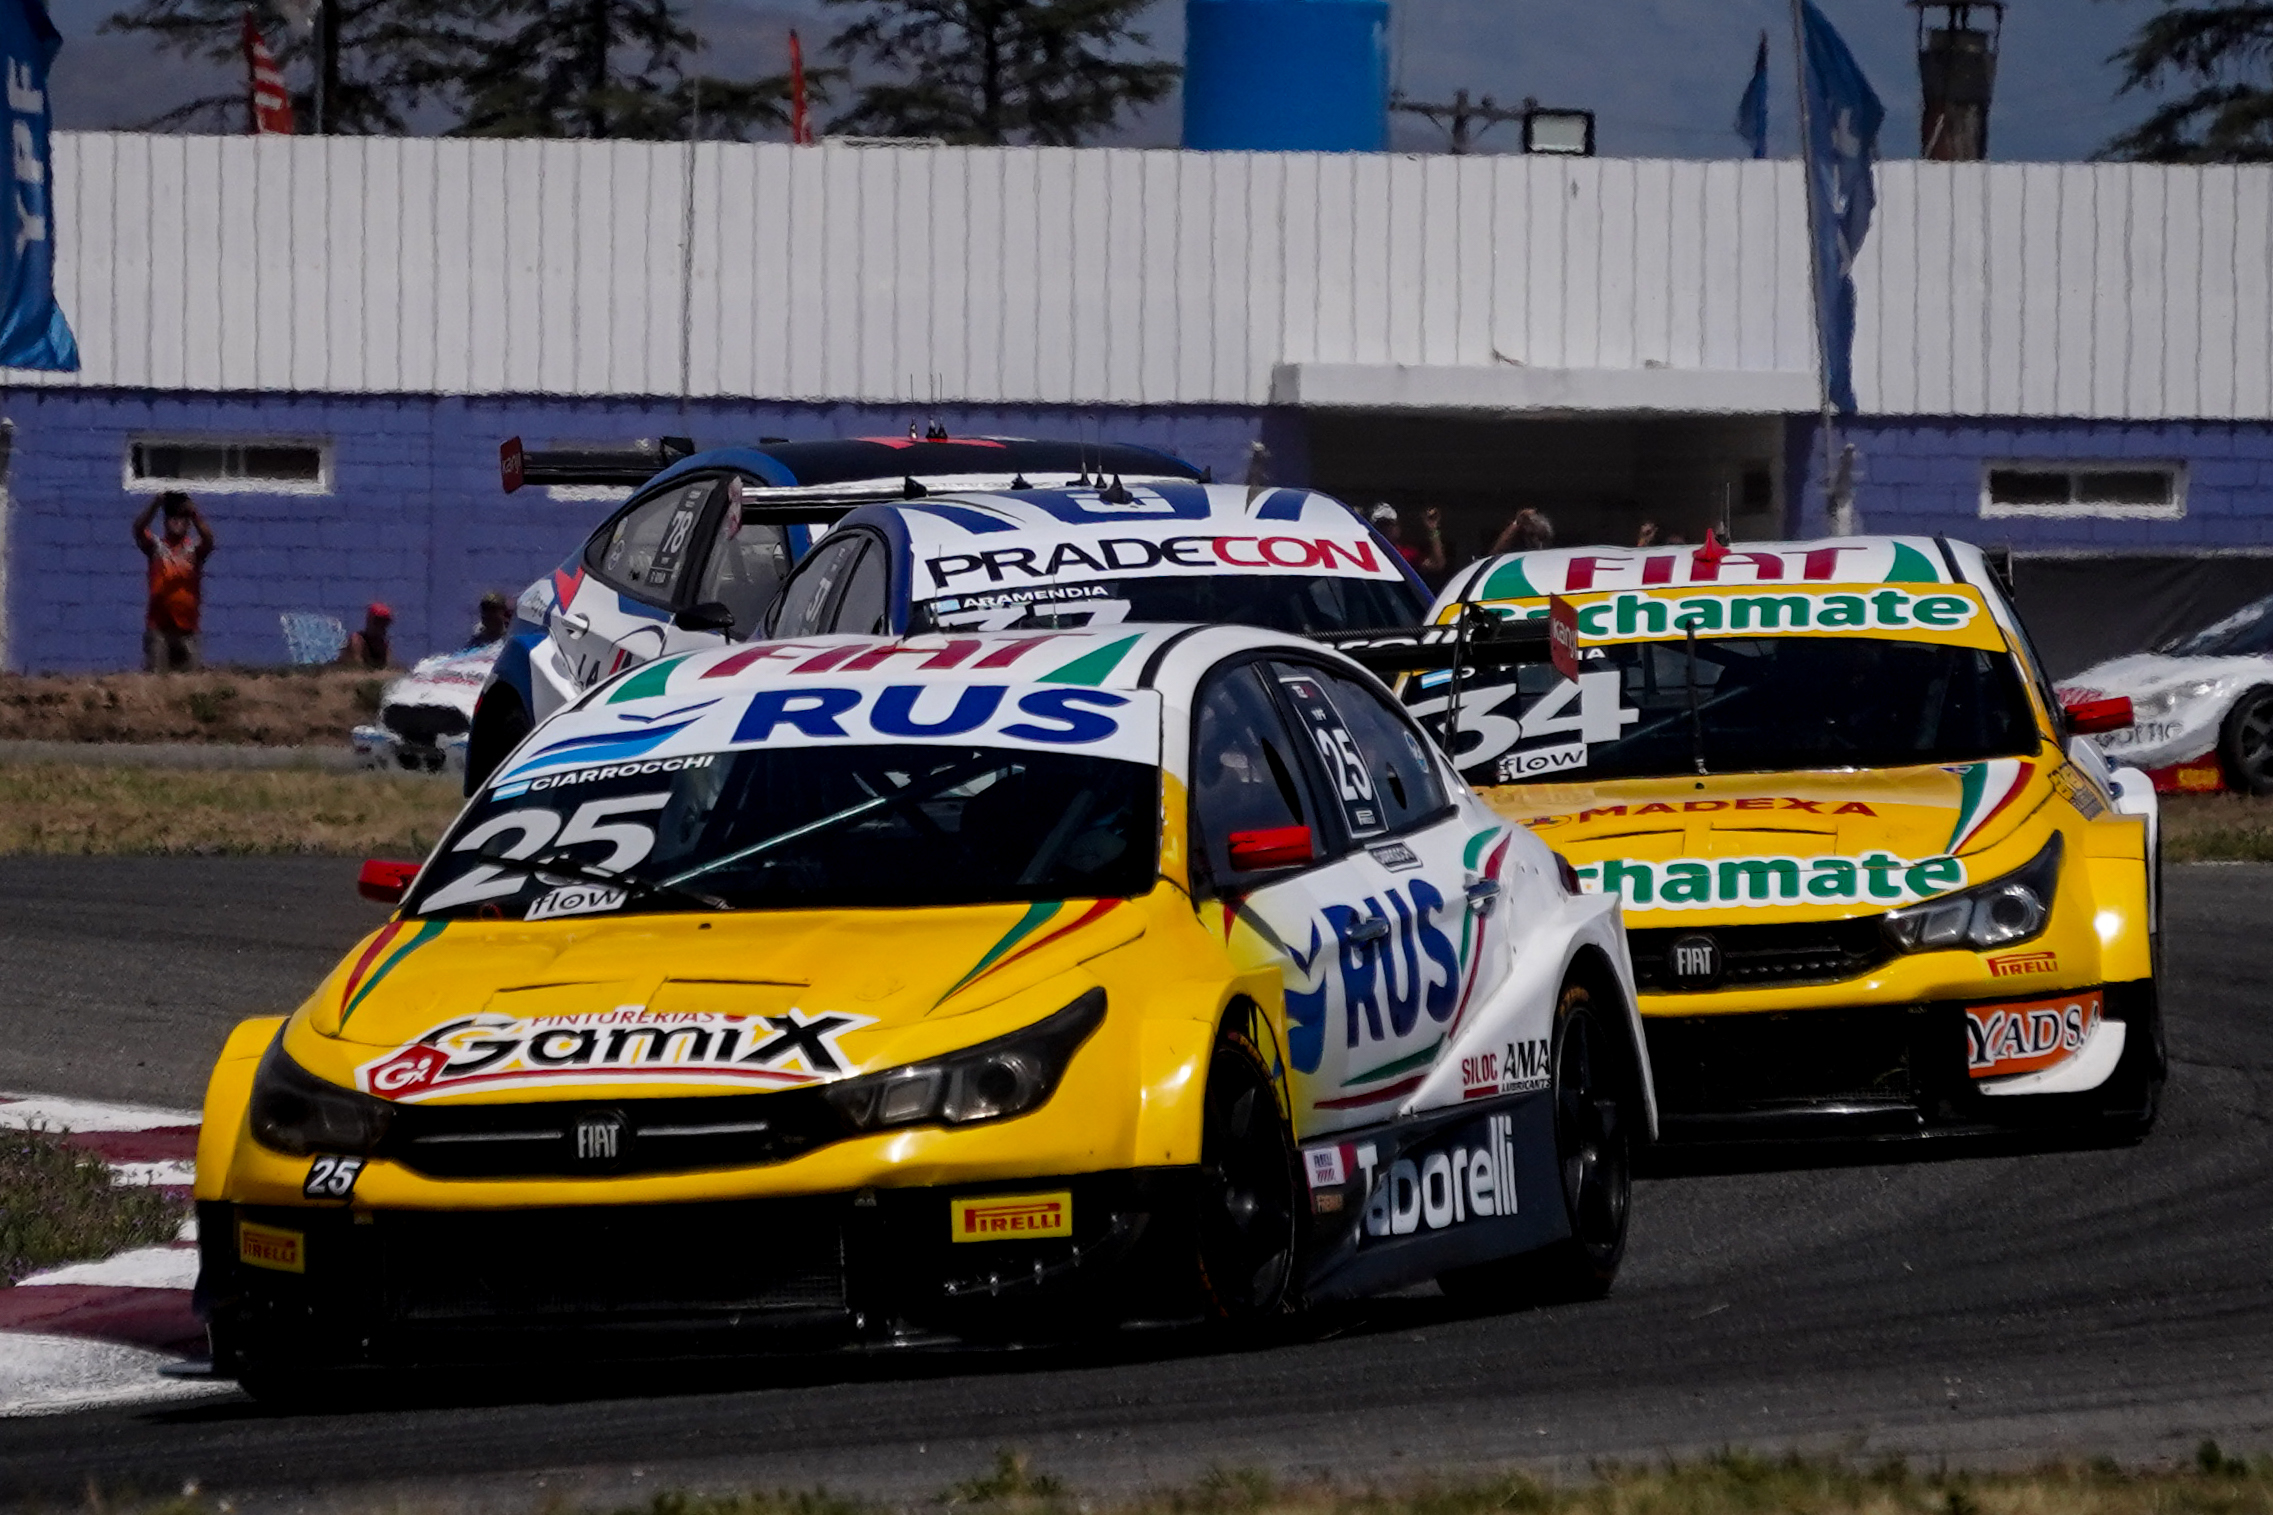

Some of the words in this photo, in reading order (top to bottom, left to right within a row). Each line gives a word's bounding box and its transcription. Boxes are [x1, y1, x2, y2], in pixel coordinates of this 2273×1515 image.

[8, 57, 46, 258] YPF
[662, 511, 694, 553] 78
[925, 536, 1381, 588] PRADECON
[1565, 546, 1868, 591] FIAT
[963, 585, 1109, 608] ARAMENDIA
[1497, 590, 1970, 635] chamate
[698, 633, 1100, 680] FIAT
[730, 684, 1134, 744] RUS
[1406, 671, 1640, 772] 34
[531, 755, 715, 791] CIARROCCHI
[1316, 728, 1373, 801] 25
[1505, 750, 1585, 775] flow
[1579, 797, 1878, 823] MADEXA
[417, 792, 673, 916] 25
[532, 888, 627, 916] flow
[1321, 878, 1460, 1049] RUS
[1676, 946, 1713, 976] FIAT
[1986, 951, 2059, 977] PIRELLI
[531, 1008, 715, 1027] PINTURERIAS
[1462, 1053, 1498, 1086] SILOC
[1503, 1039, 1550, 1079] AMA
[577, 1125, 619, 1158] FIAT
[306, 1157, 362, 1196] 25
[964, 1202, 1061, 1234] PIRELLI
[243, 1230, 296, 1265] PIRELLI
